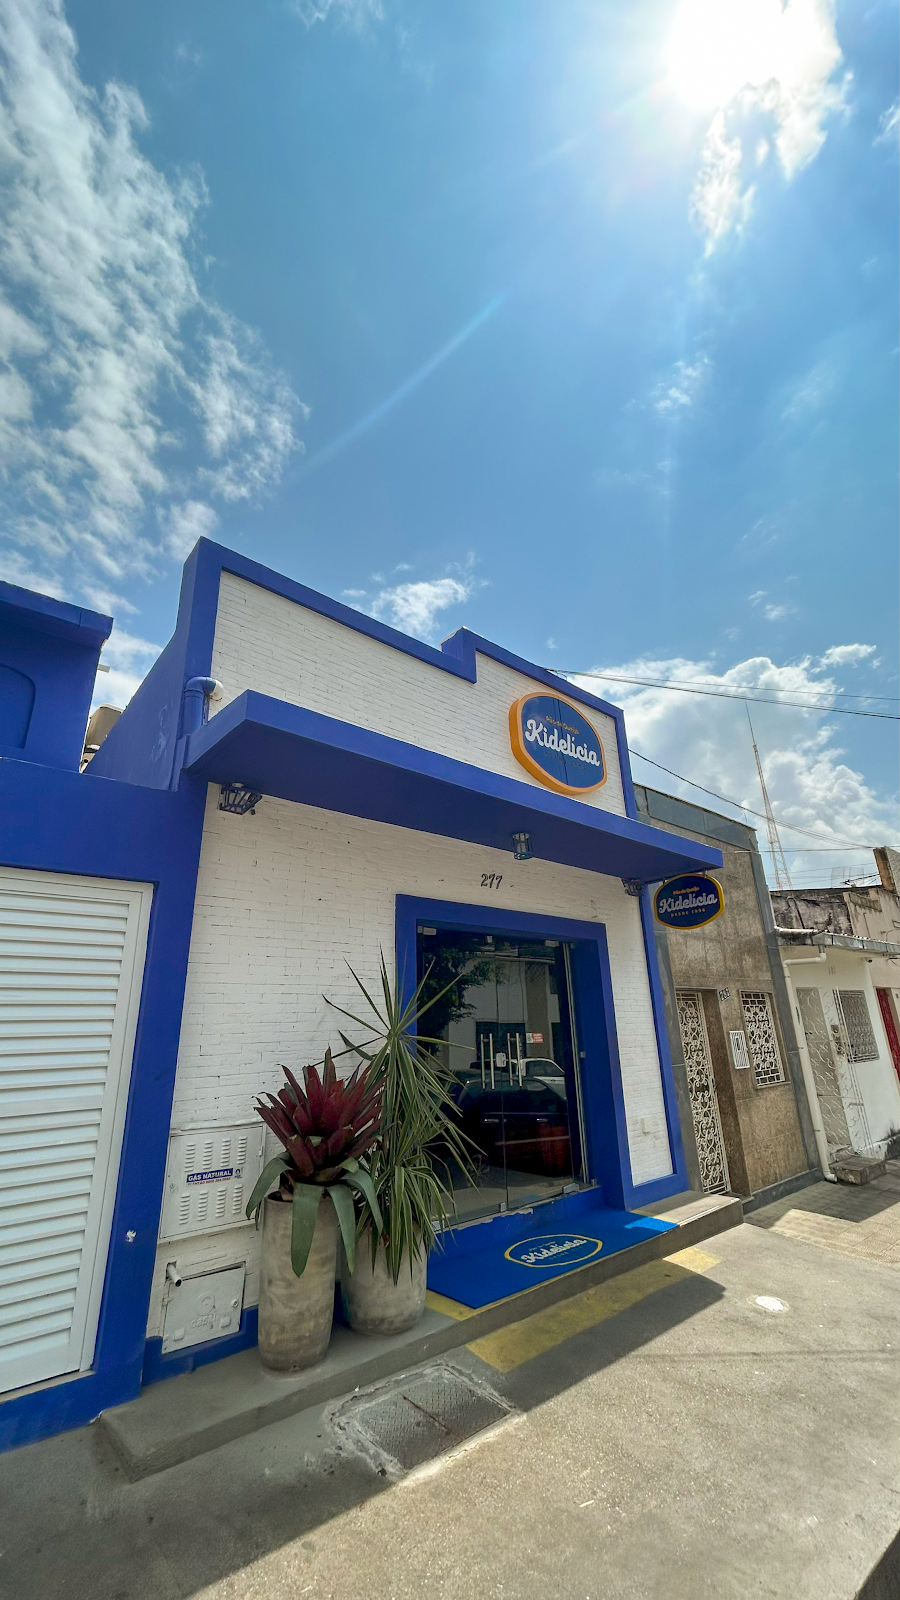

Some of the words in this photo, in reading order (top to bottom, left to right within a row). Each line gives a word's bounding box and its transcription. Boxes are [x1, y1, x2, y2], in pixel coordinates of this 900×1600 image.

[525, 719, 600, 766] Kidelícia
[481, 873, 503, 889] 277
[658, 893, 718, 914] Kidelícia
[203, 1170, 232, 1179] NATURAL
